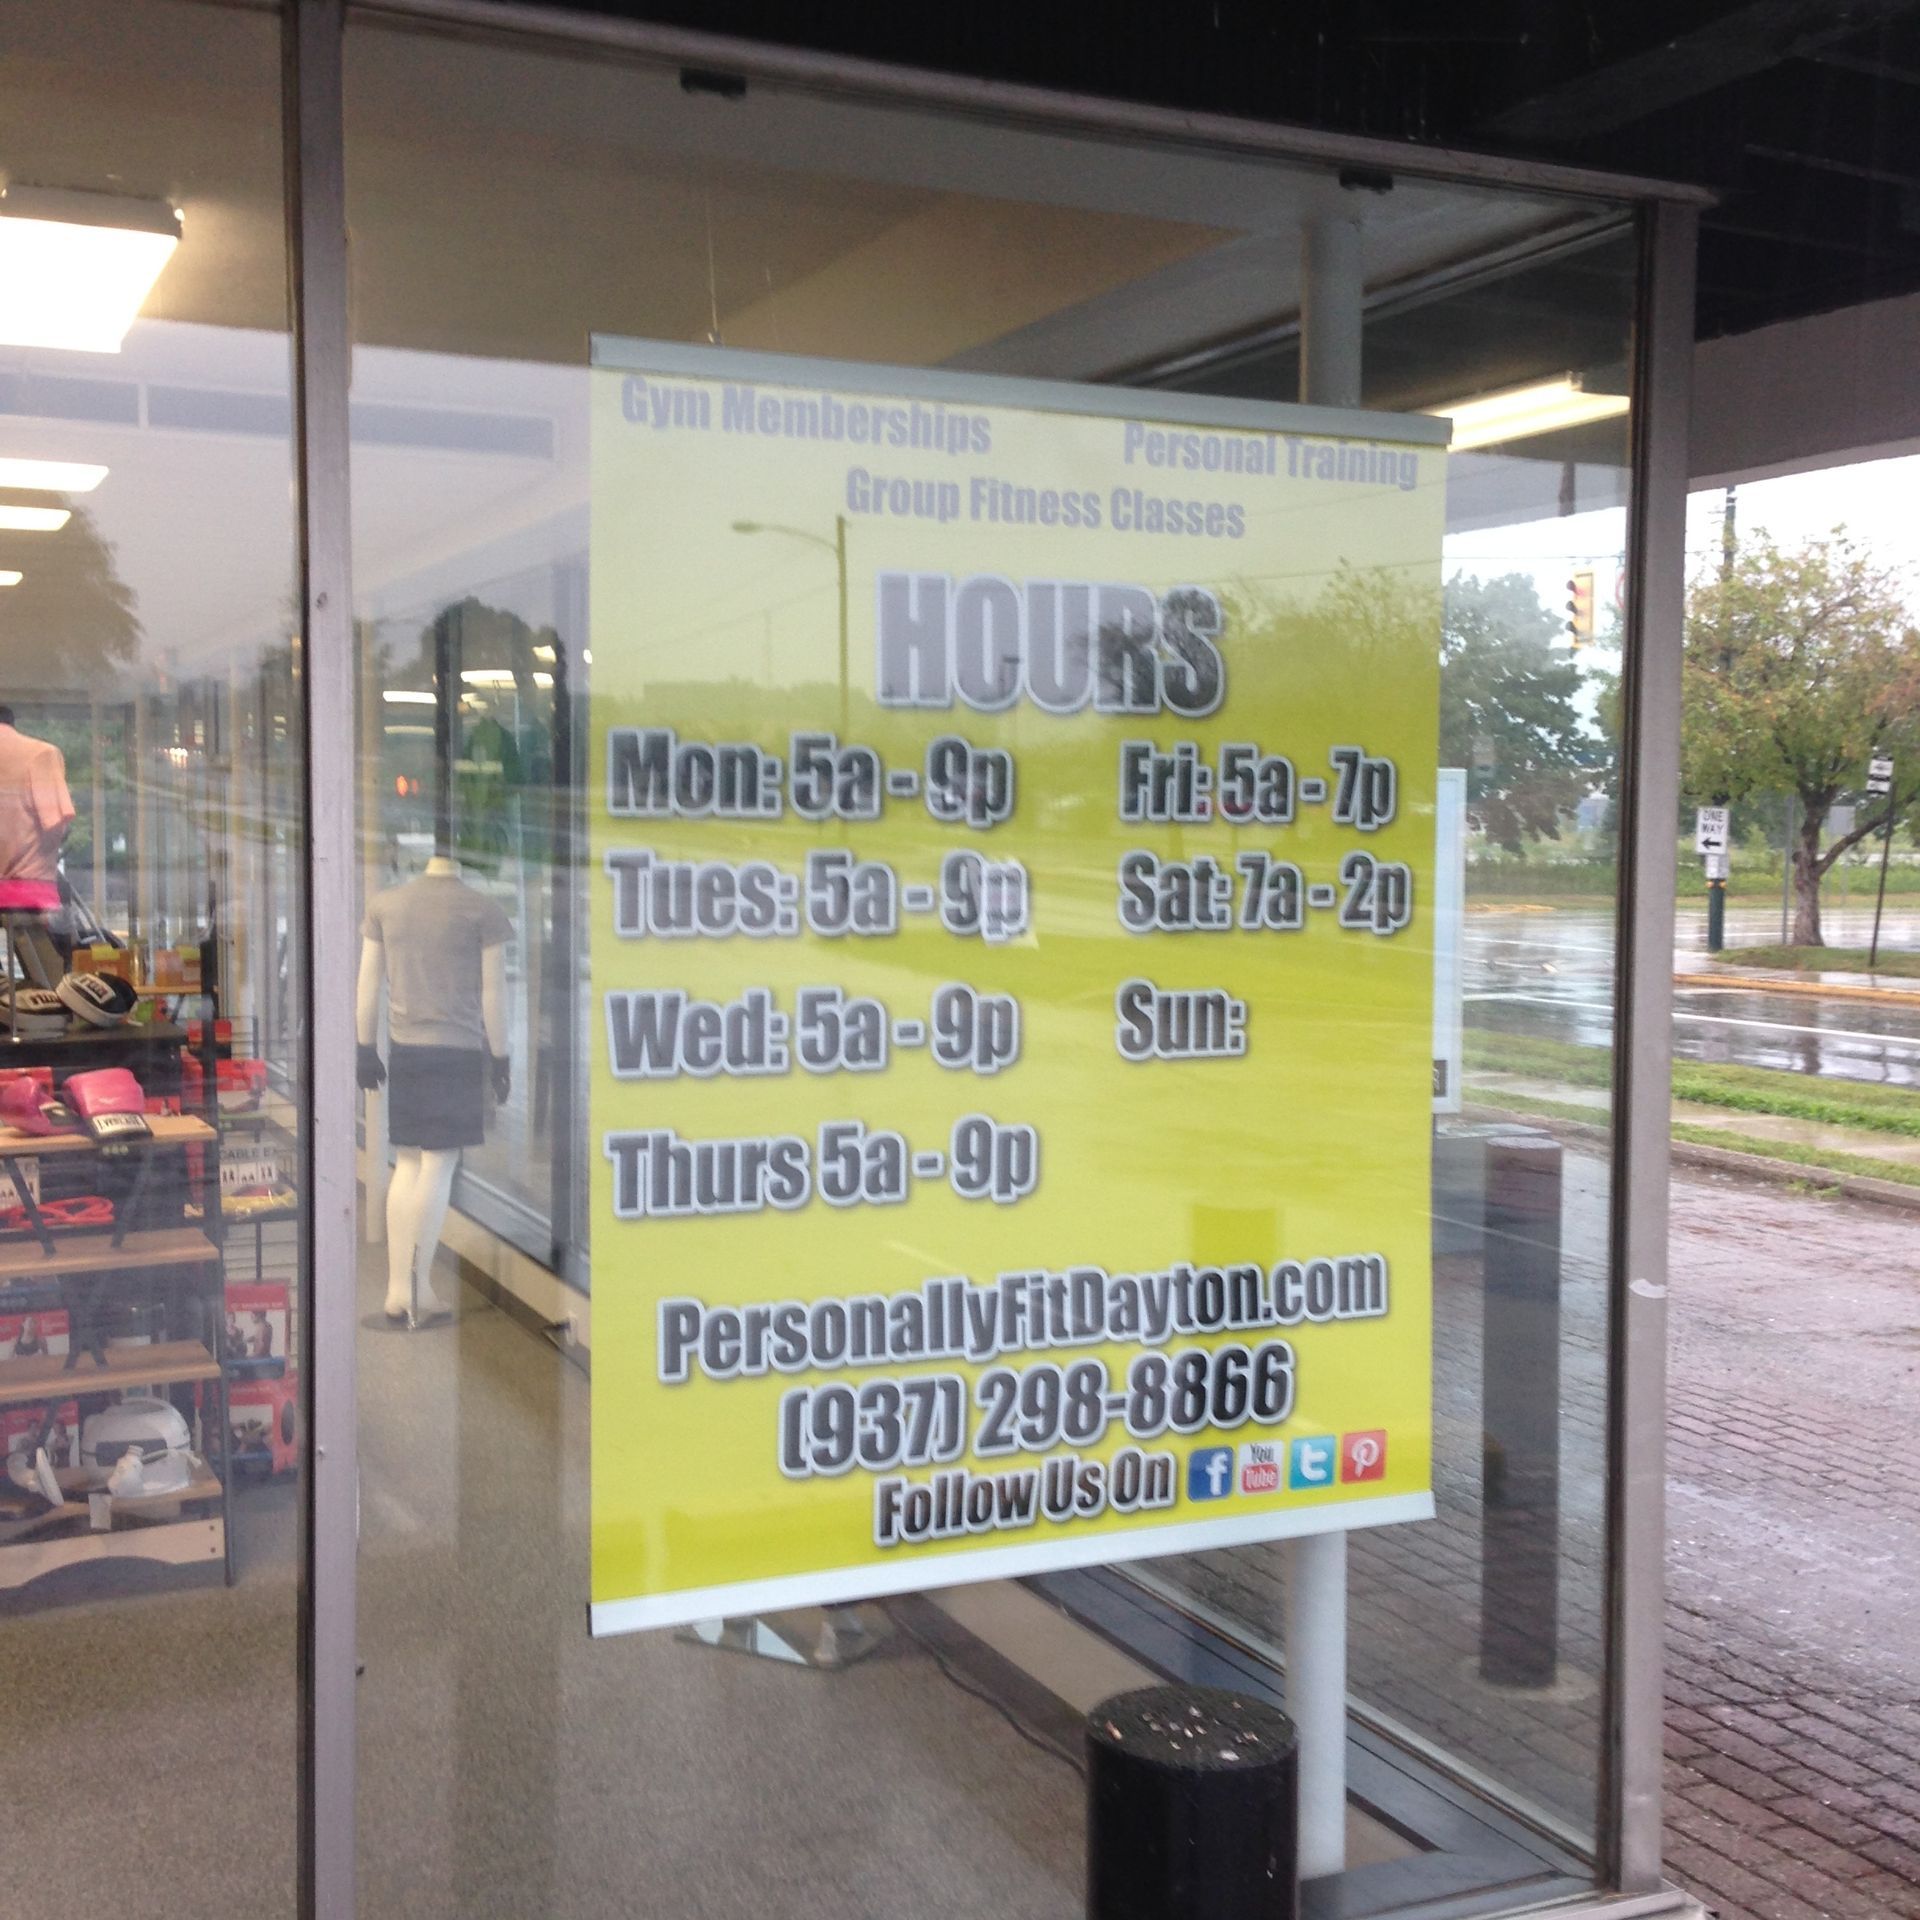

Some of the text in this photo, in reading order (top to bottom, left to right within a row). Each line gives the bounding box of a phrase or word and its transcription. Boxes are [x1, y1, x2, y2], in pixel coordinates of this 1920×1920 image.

[620, 374, 993, 456] Gym Memberships
[1123, 421, 1419, 491] Personal Training
[845, 468, 1245, 539] Group Fitness Classes
[875, 572, 1225, 717] HOURS
[607, 727, 783, 820] Mon:
[790, 732, 882, 821] 5a
[925, 735, 1015, 828] 9p
[1119, 741, 1211, 824] Fri:
[1218, 744, 1294, 824] 5a
[1330, 746, 1397, 831] 7p
[1702, 809, 1723, 822] ONE
[1702, 823, 1724, 834] WAY
[605, 849, 799, 939] Tues:
[805, 849, 896, 936] 5a
[940, 849, 1029, 945] 9p
[1117, 849, 1232, 935] Sat:
[1238, 850, 1303, 932] 7a
[1339, 850, 1412, 935] 2p
[607, 987, 792, 1081] Wed:
[797, 984, 888, 1073] 5a
[930, 983, 1020, 1074] 9p
[1116, 980, 1247, 1061] Sun:
[605, 1125, 811, 1222] Thurs
[816, 1119, 909, 1205] 5a
[950, 1115, 1038, 1203] 9p
[656, 1252, 1389, 1386] PersonallyFitDayton.com
[778, 1340, 1294, 1479] (937) 298-8866
[1250, 1444, 1275, 1463] You
[872, 1448, 1178, 1548] Follow Us On
[1246, 1467, 1277, 1490] Tube
